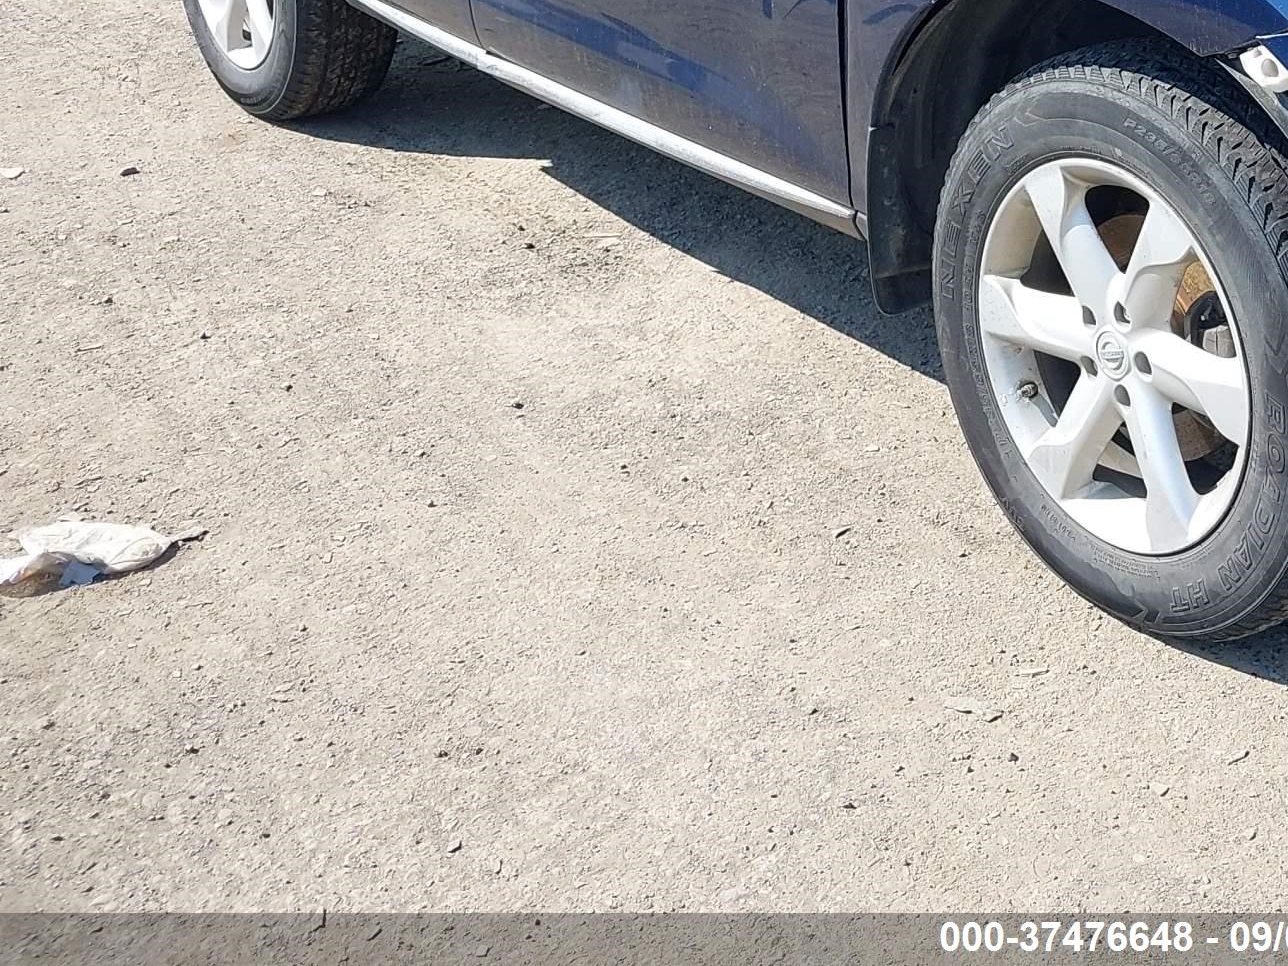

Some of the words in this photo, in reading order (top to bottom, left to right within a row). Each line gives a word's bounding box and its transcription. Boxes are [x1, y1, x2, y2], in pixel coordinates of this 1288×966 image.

[941, 123, 1015, 300] NEXEN
[1216, 389, 1286, 591] ROADIAN
[1170, 578, 1210, 613] HT
